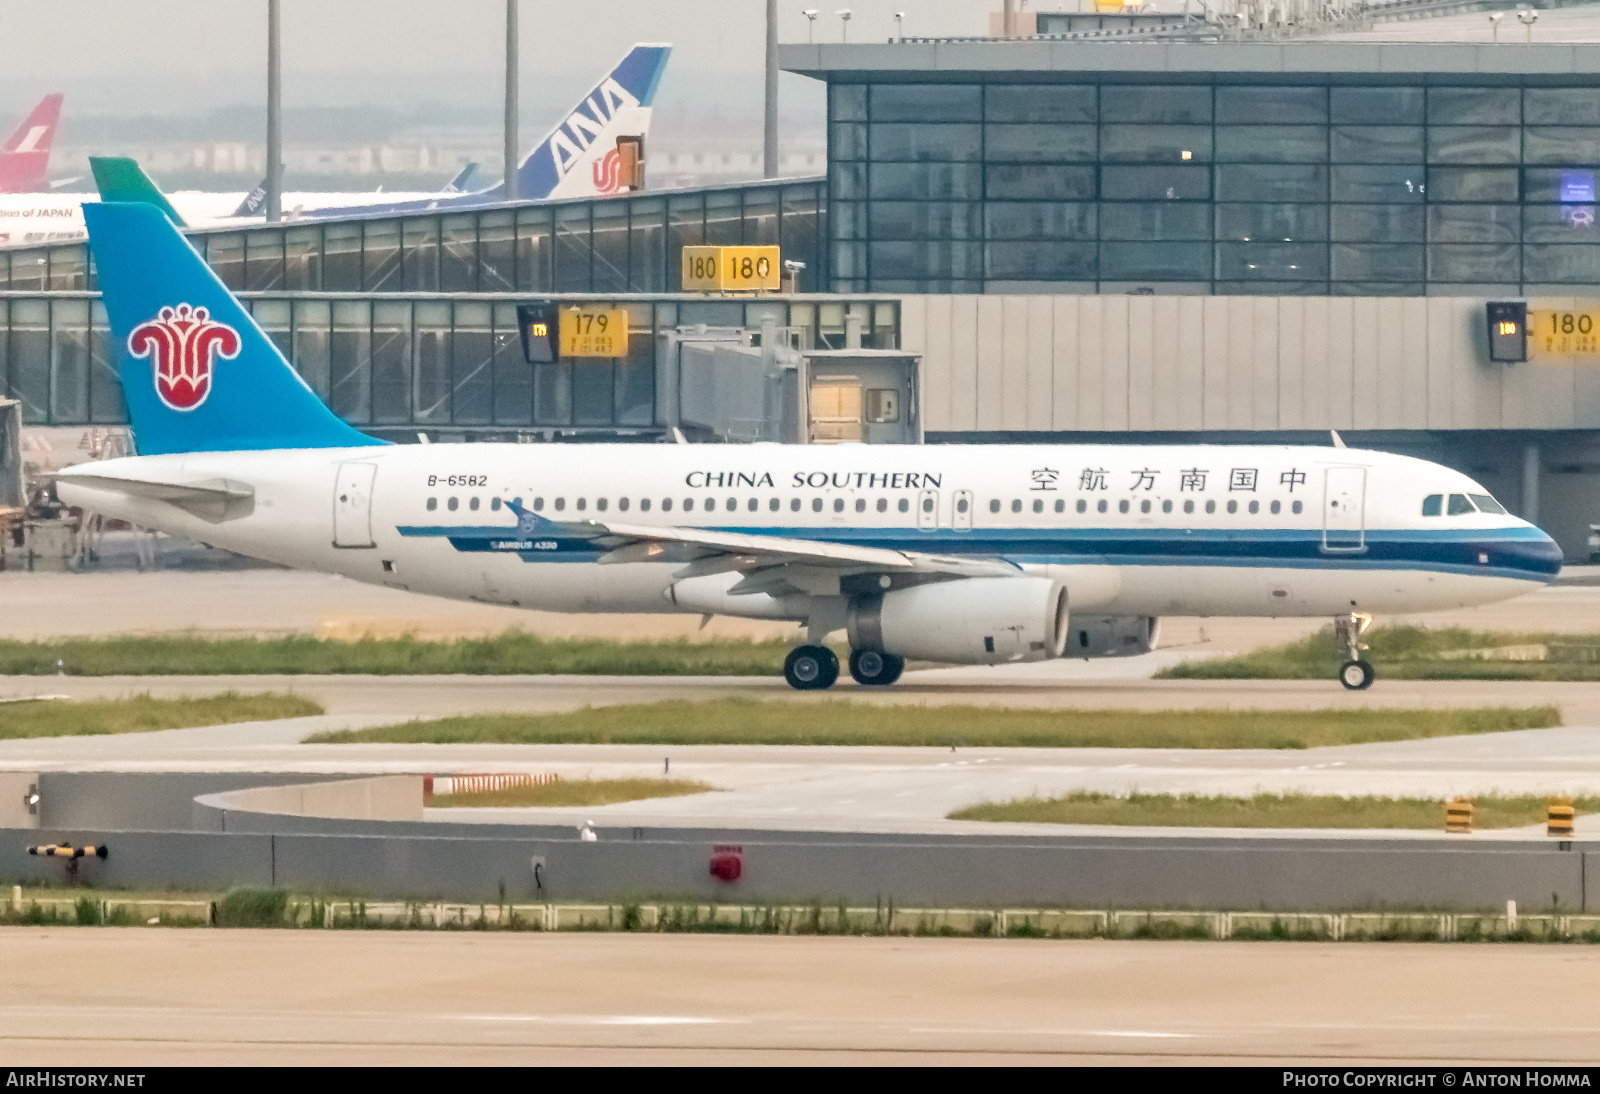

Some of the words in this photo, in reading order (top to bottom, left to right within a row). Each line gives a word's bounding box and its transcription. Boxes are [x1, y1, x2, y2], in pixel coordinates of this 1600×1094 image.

[549, 78, 641, 180] ANA
[22, 208, 35, 218] of
[36, 208, 74, 219] JAPAN
[689, 256, 716, 279] 180
[731, 256, 770, 279] 180
[576, 313, 609, 335] 179
[1499, 322, 1516, 335] 180
[1551, 313, 1593, 334] 180
[427, 474, 488, 487] B-6582
[685, 471, 775, 488] CHINA
[792, 472, 942, 489] SOUTHERN
[498, 541, 533, 550] AIRBUS
